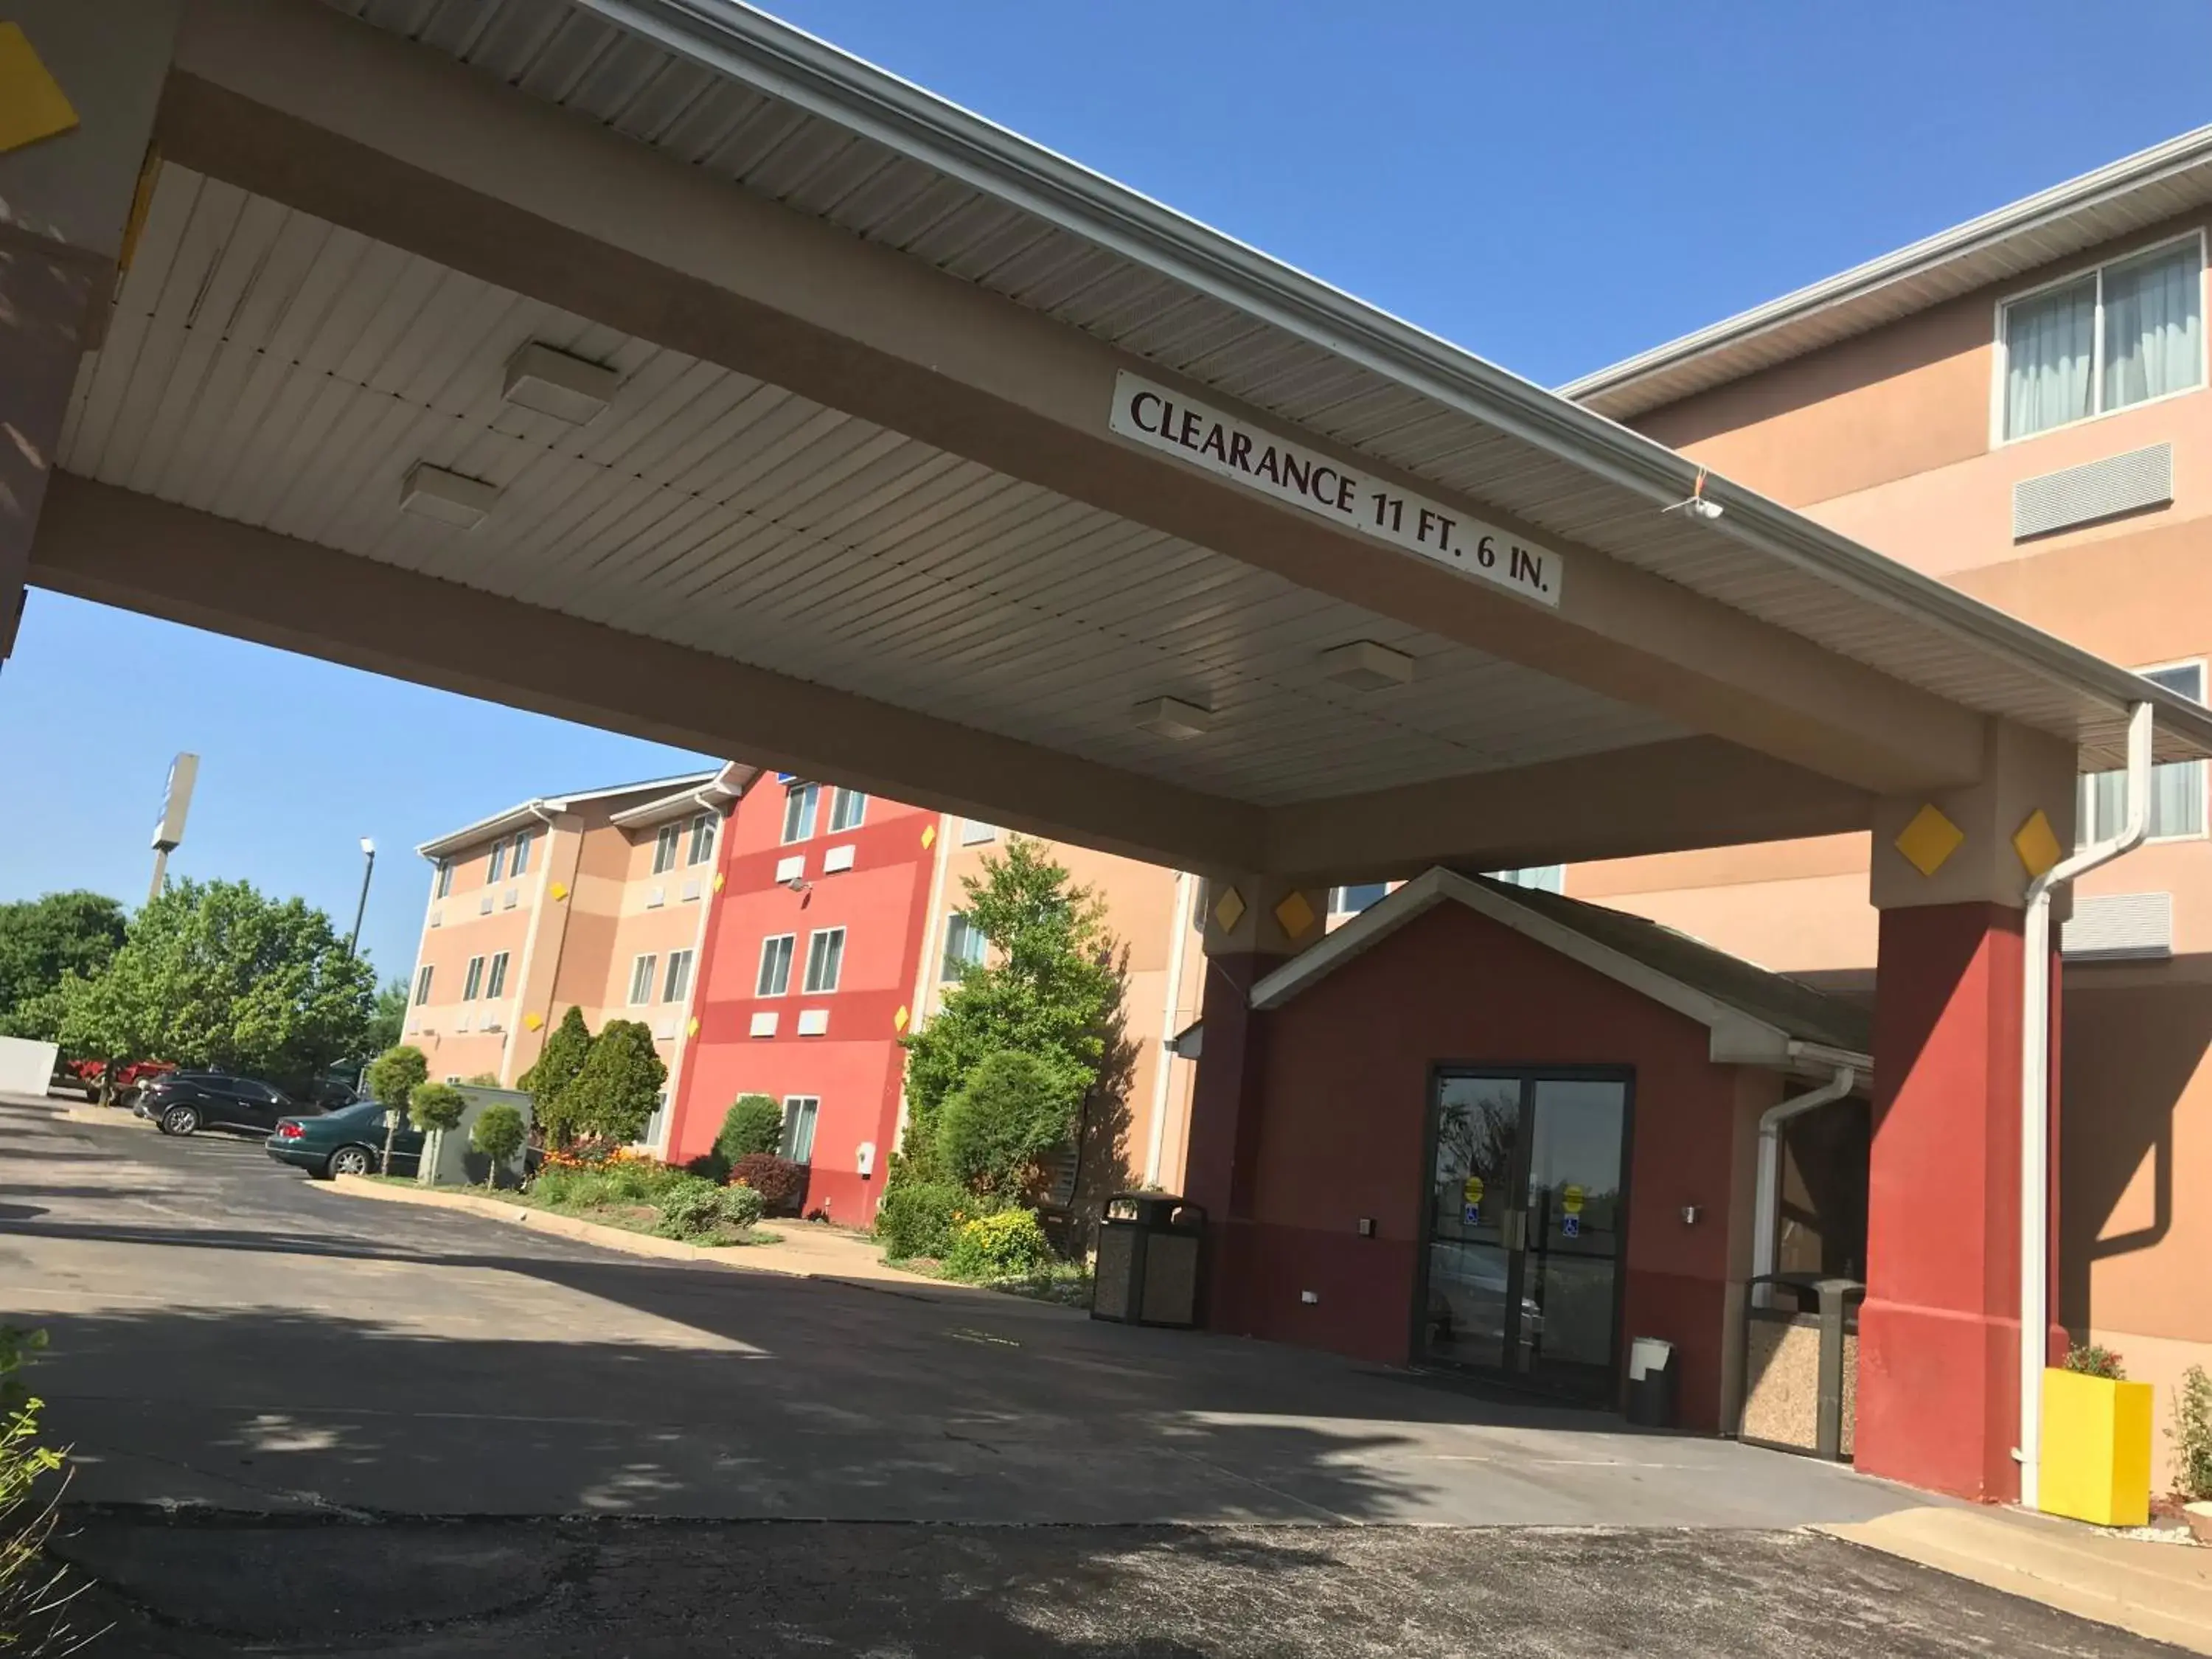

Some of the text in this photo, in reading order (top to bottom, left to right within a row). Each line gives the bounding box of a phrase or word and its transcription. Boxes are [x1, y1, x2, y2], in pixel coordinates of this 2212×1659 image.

[1130, 392, 1548, 591] CLEARANCE 11 FT. 6 IN.
